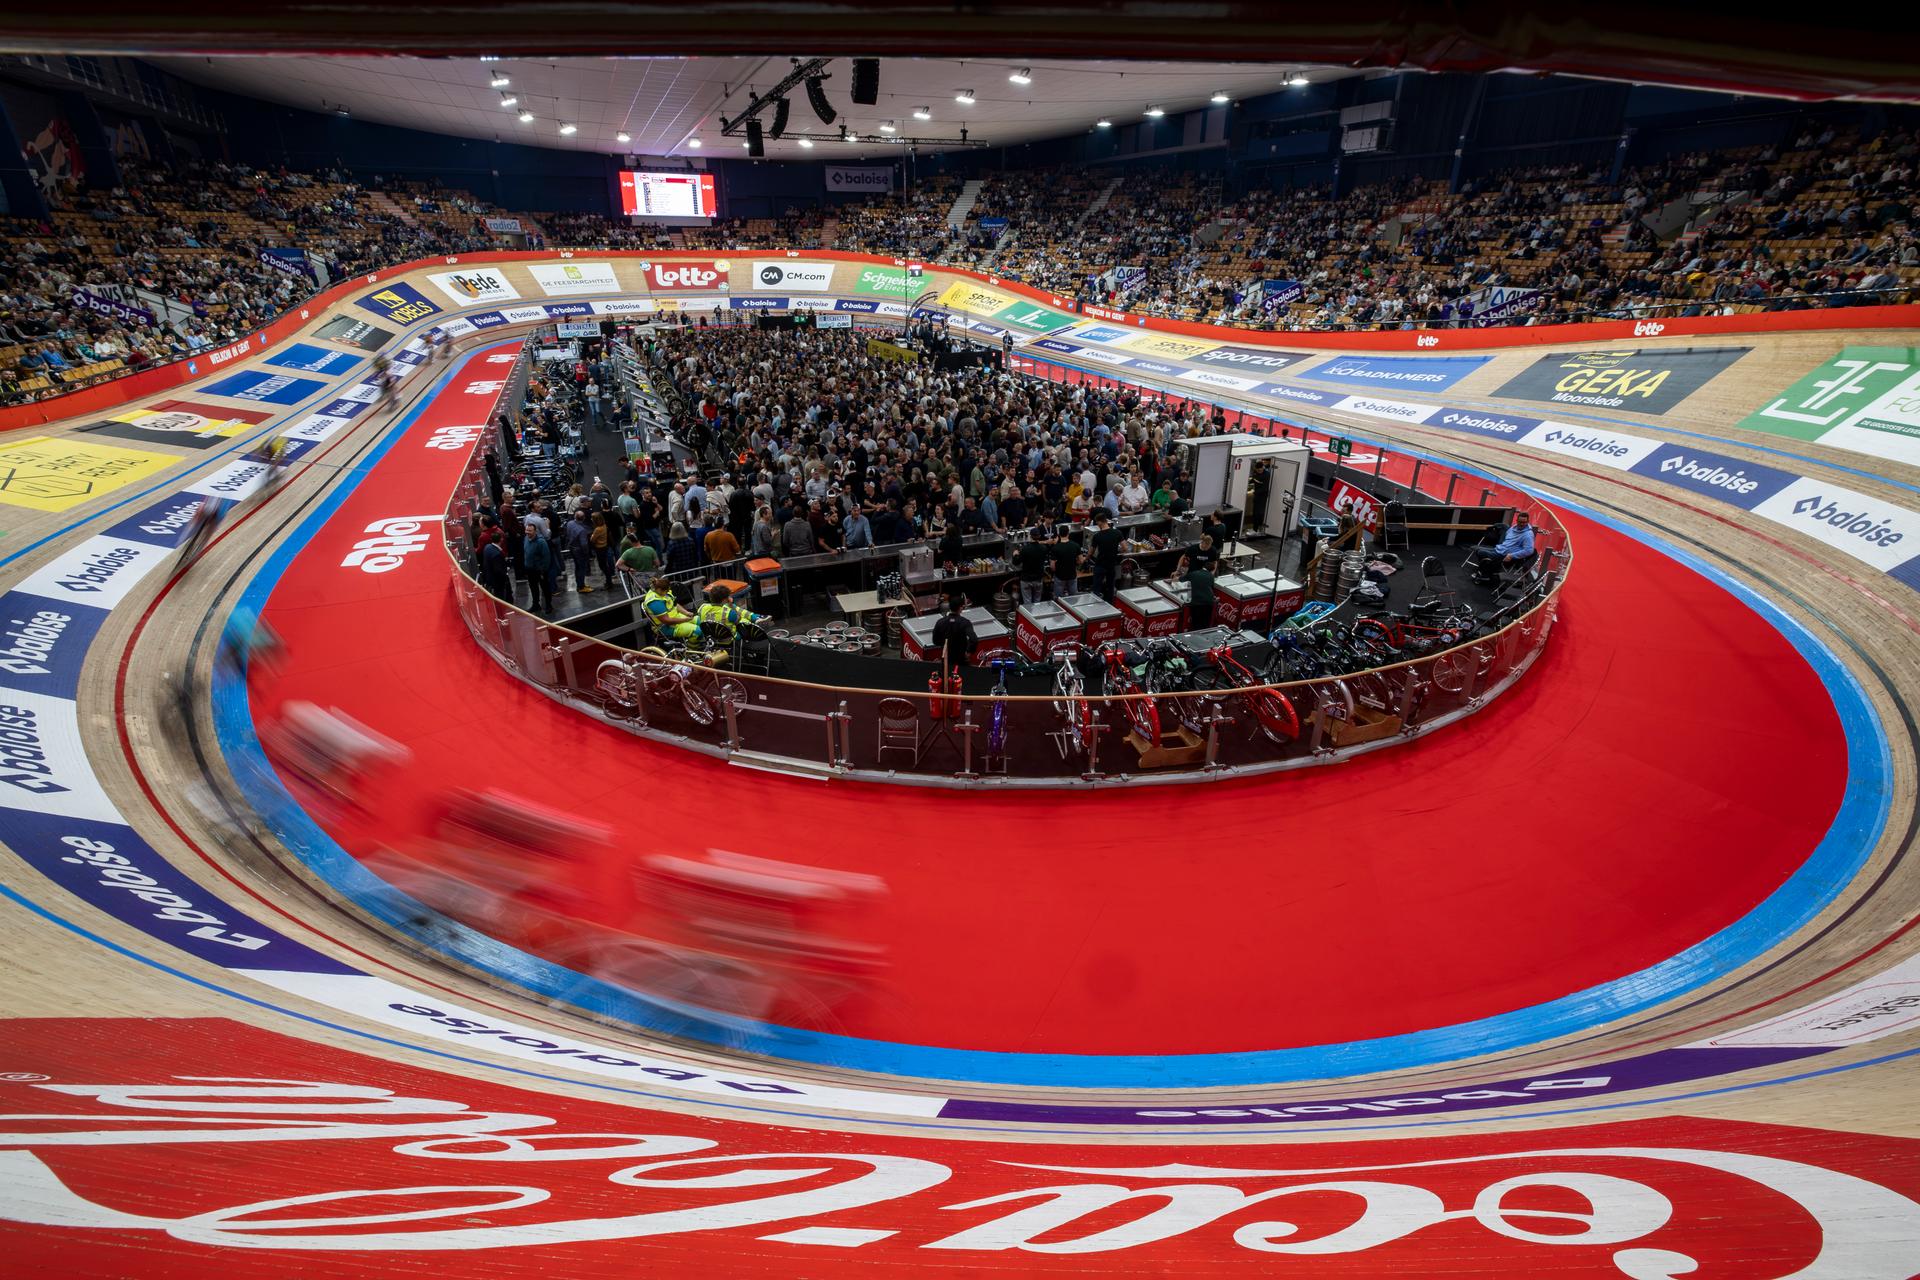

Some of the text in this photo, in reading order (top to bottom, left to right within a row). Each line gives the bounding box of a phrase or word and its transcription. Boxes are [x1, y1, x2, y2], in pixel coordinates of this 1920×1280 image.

[845, 171, 888, 185] baloise
[489, 221, 518, 230] radio2
[269, 255, 301, 276] baloise
[455, 273, 500, 291] Pede
[787, 272, 826, 281] CM.com
[862, 271, 925, 287] Schneider
[1127, 271, 1147, 286] baloise
[884, 284, 919, 294] Electric
[1272, 286, 1300, 306] baloise
[612, 303, 641, 311] baloise
[969, 293, 1003, 306] SPORT
[1490, 295, 1537, 319] baloise
[388, 301, 433, 323] NOBELS
[517, 311, 540, 319] baloise
[560, 306, 586, 314] baloise
[1350, 370, 1447, 382] BADKAMERS
[1555, 369, 1671, 398] GEKA
[1284, 389, 1324, 401] baloise
[1551, 392, 1624, 407] Moorslede
[1366, 402, 1417, 417] baloise
[1457, 415, 1518, 433] baloise
[1561, 432, 1629, 458] baloise
[1677, 460, 1758, 494] baloise
[1815, 503, 1904, 548] baloise
[73, 547, 141, 589] baloise
[5, 610, 72, 664] baloise
[61, 836, 228, 925] baloise
[388, 1002, 709, 1081] baloise
[1136, 1086, 1536, 1119] baloise
